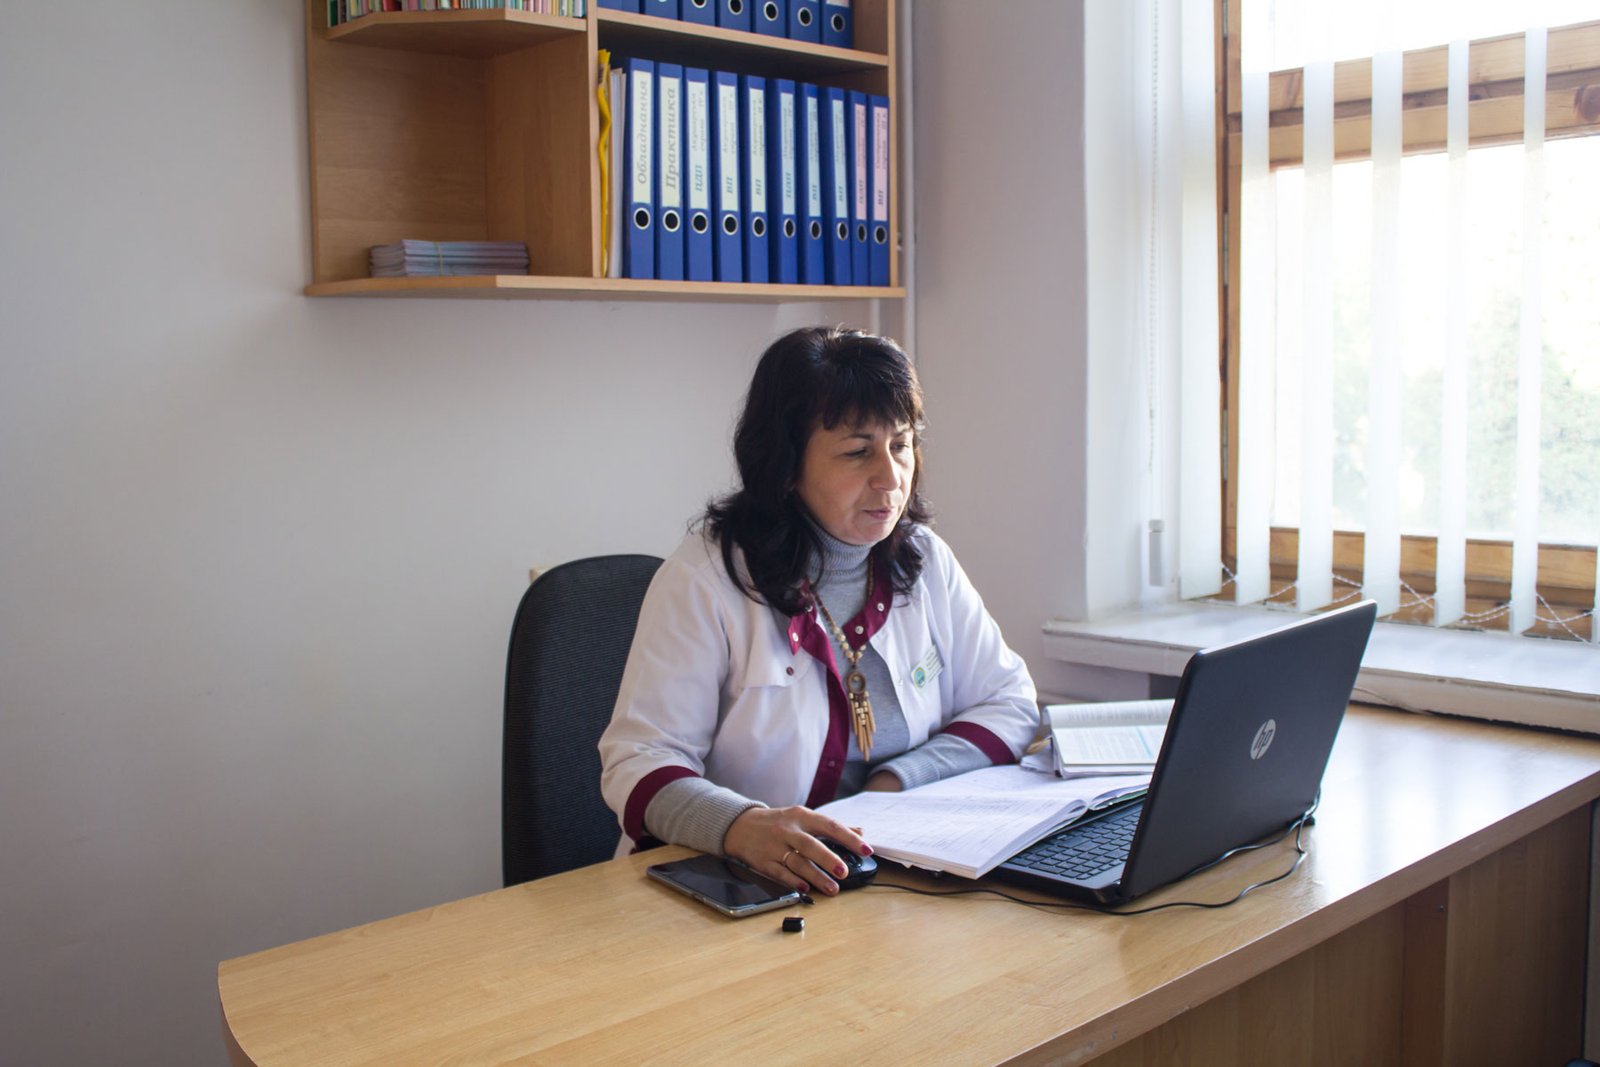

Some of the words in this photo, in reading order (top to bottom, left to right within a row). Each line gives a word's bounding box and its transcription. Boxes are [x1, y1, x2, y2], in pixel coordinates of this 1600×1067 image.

[637, 80, 648, 185] Обладнання
[665, 88, 679, 190] Практика
[1251, 719, 1274, 760] hp
